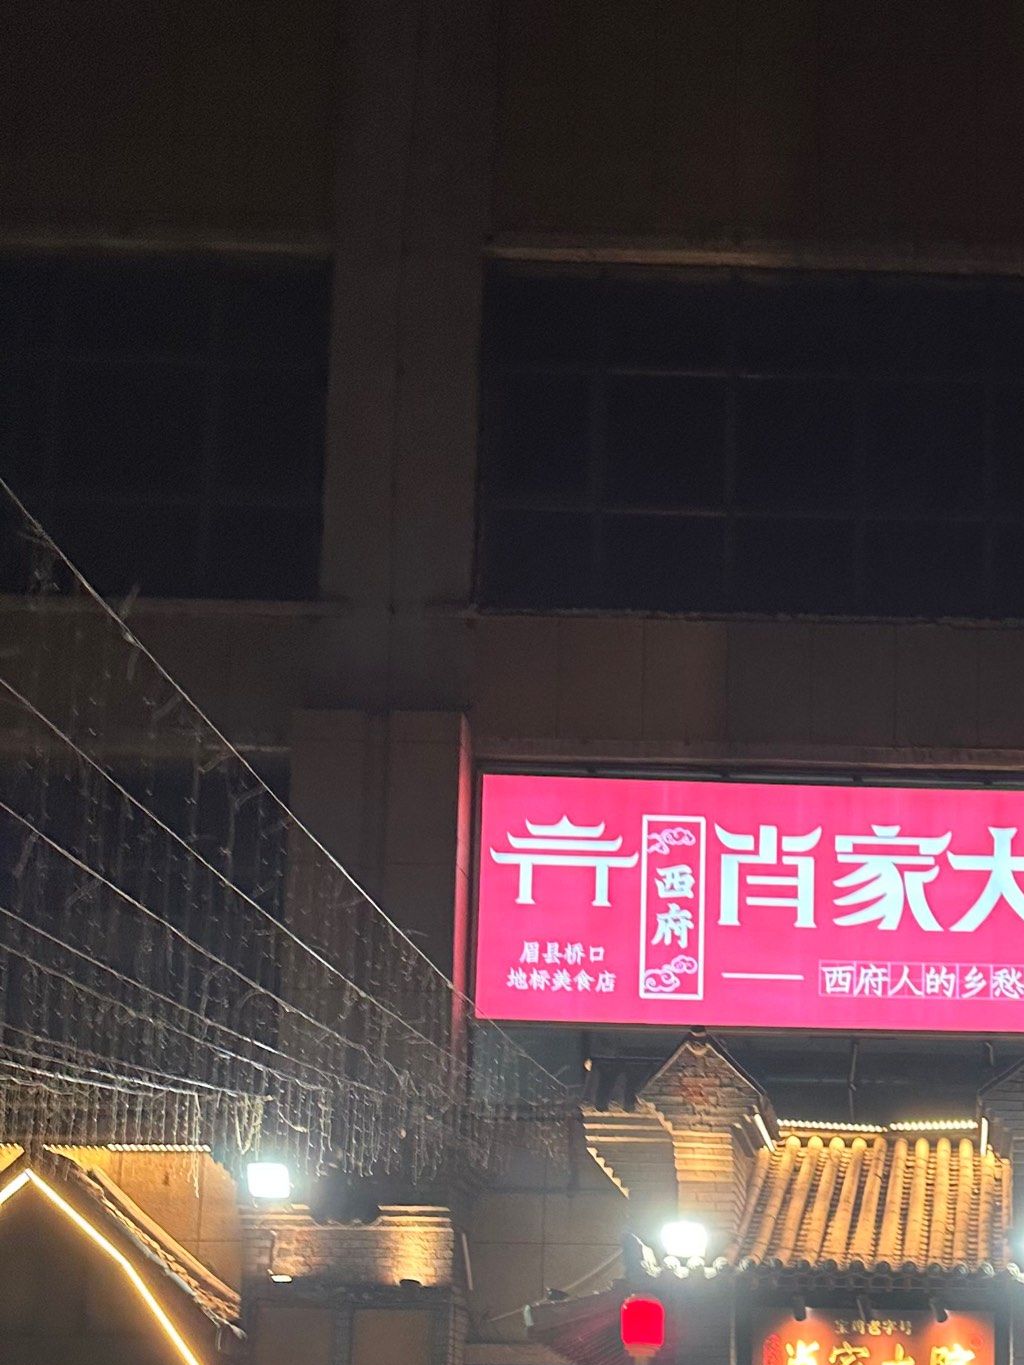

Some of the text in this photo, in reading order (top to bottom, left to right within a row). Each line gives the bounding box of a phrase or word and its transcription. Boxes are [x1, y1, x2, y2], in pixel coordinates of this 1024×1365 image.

[650, 863, 697, 949] 西府
[518, 940, 606, 965] 眉县桥口
[506, 966, 617, 993] 地标美食店
